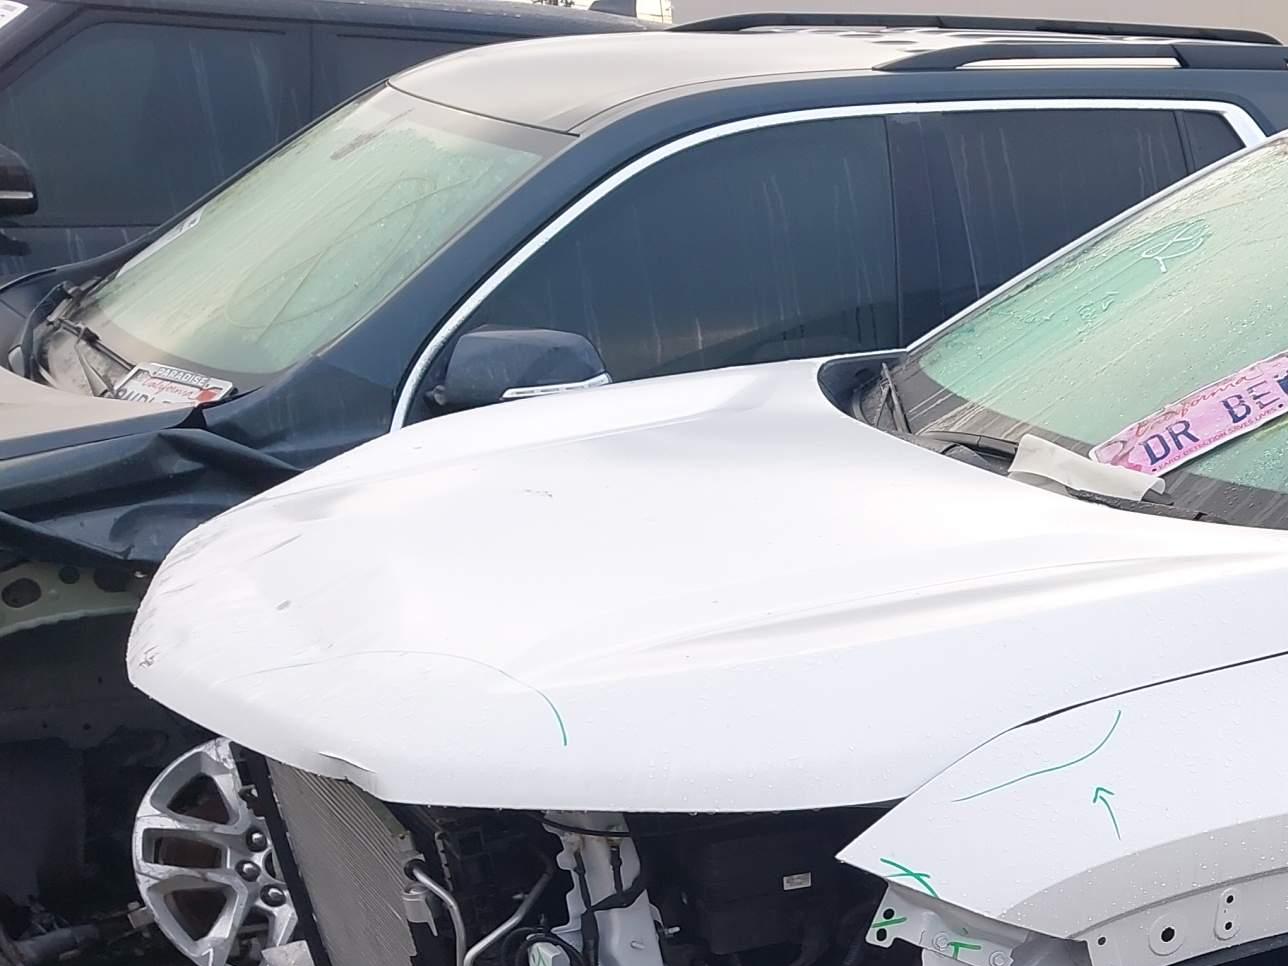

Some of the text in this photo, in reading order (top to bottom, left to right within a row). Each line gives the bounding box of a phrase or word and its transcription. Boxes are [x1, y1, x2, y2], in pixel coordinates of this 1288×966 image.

[156, 366, 209, 387] PARADISE
[142, 378, 194, 397] California
[1139, 418, 1200, 465] DR
[1158, 452, 1182, 471] EARLY
